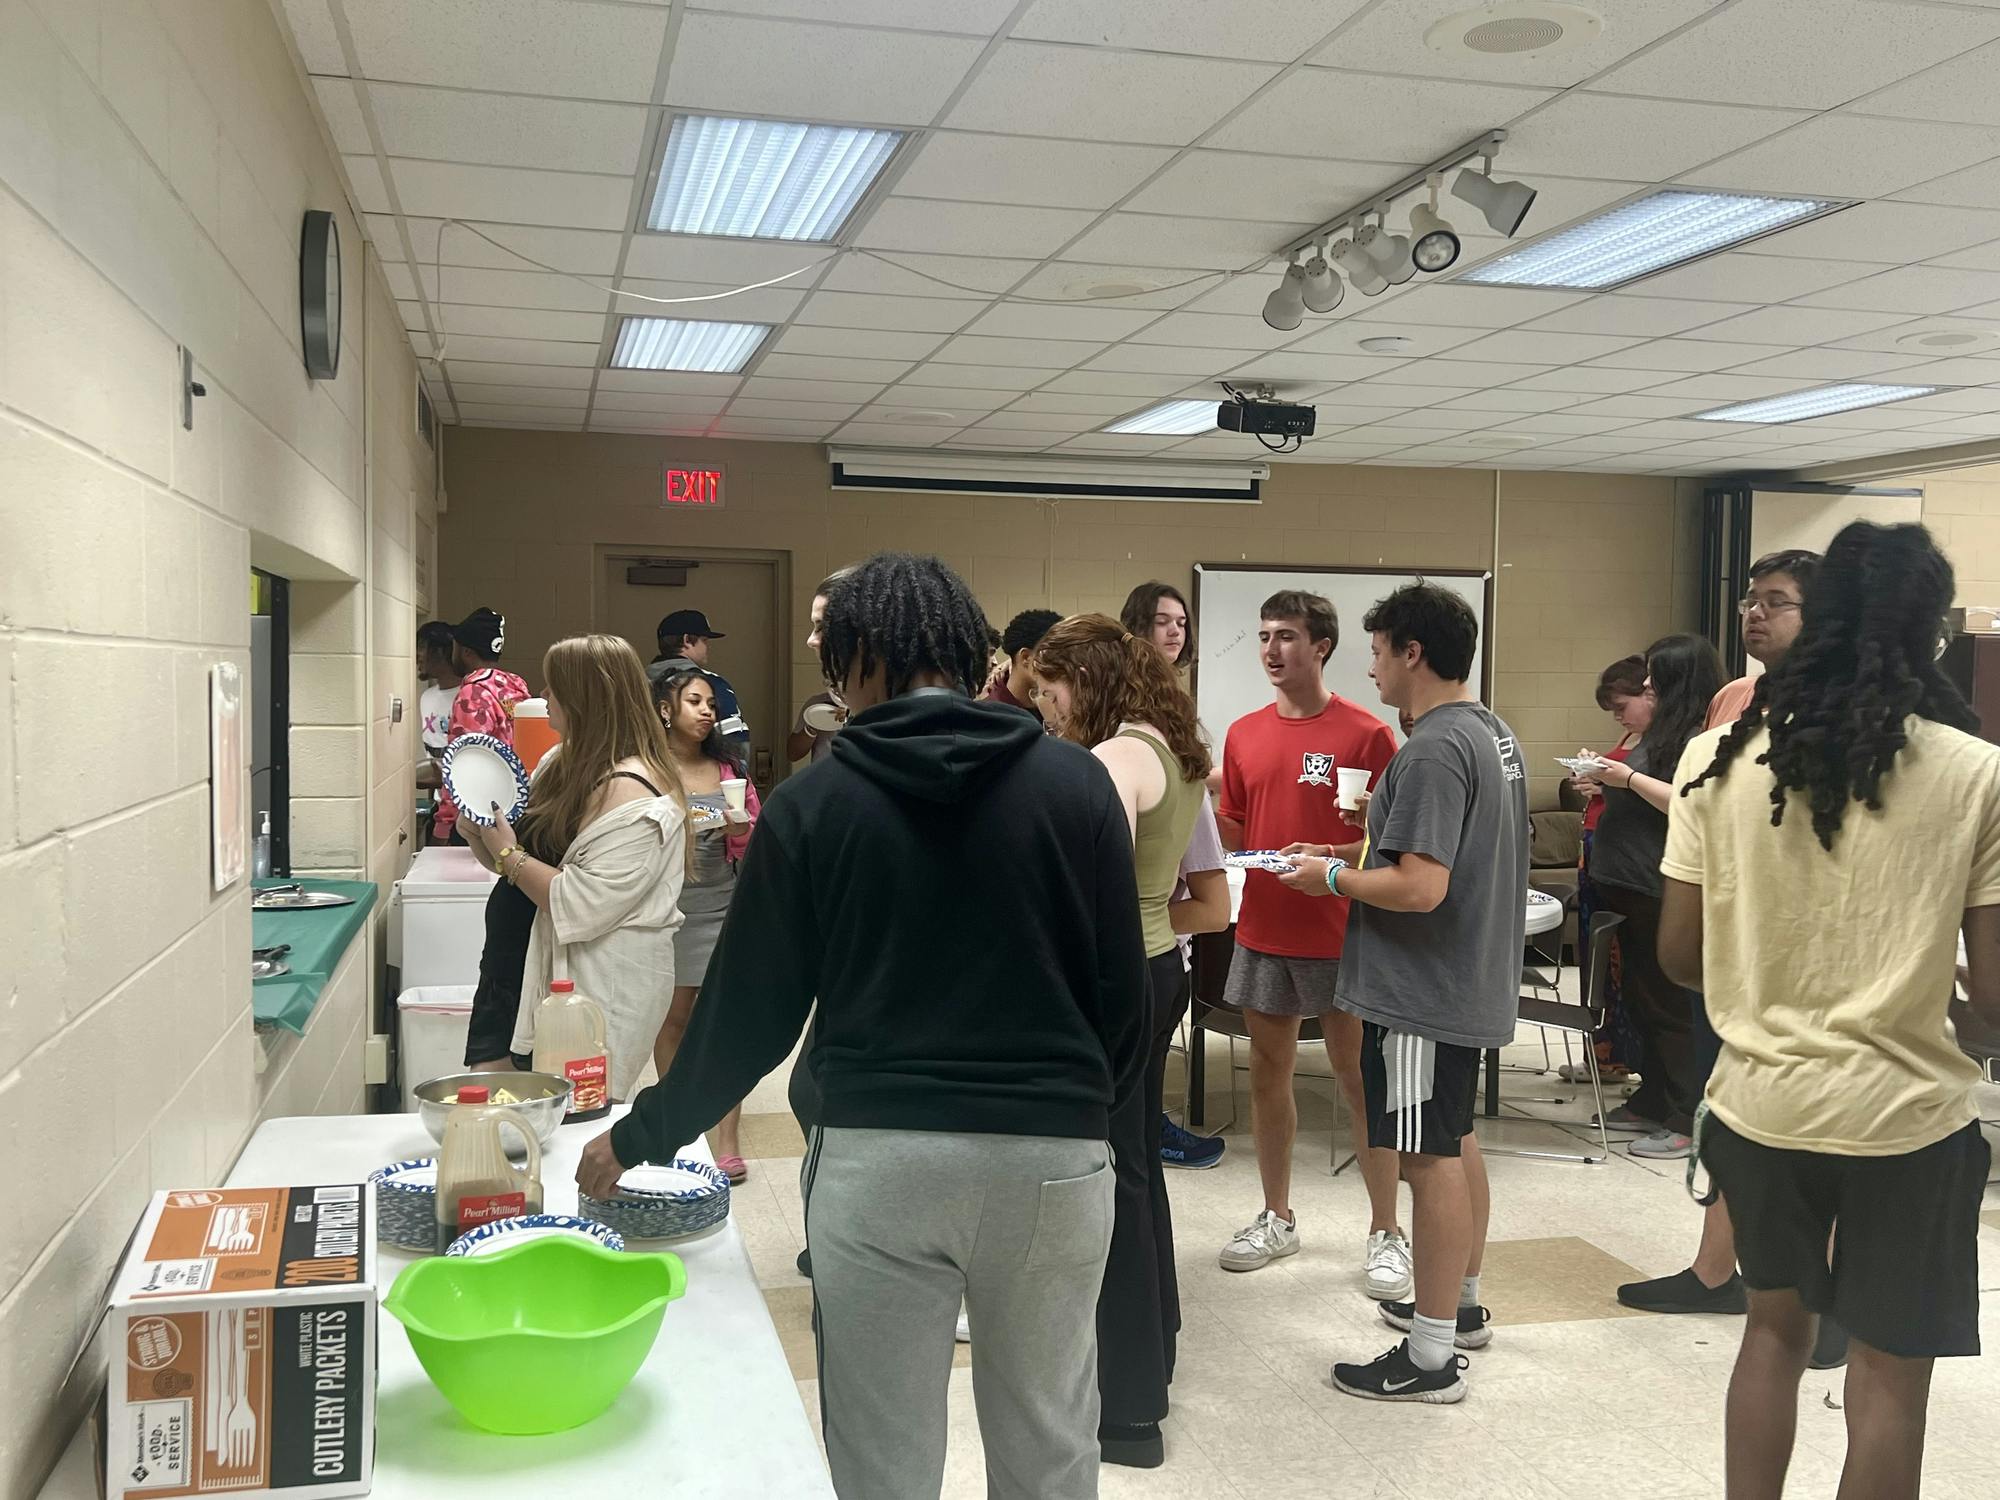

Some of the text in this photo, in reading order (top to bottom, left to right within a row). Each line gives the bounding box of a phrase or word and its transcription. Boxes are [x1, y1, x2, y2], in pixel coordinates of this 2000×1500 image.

[667, 470, 720, 503] EXIT
[569, 1067, 588, 1077] Pearl
[463, 1205, 520, 1218] Pearl Milling
[284, 1258, 359, 1285] 200
[134, 1323, 158, 1366] STRONG &
[152, 1321, 173, 1359] DURABLE
[298, 1311, 314, 1368] WHITE PLASTIC
[313, 1309, 348, 1477] CUTLERY PACKETS
[149, 1428, 163, 1461] FOOD
[168, 1415, 181, 1470] SERVICE
